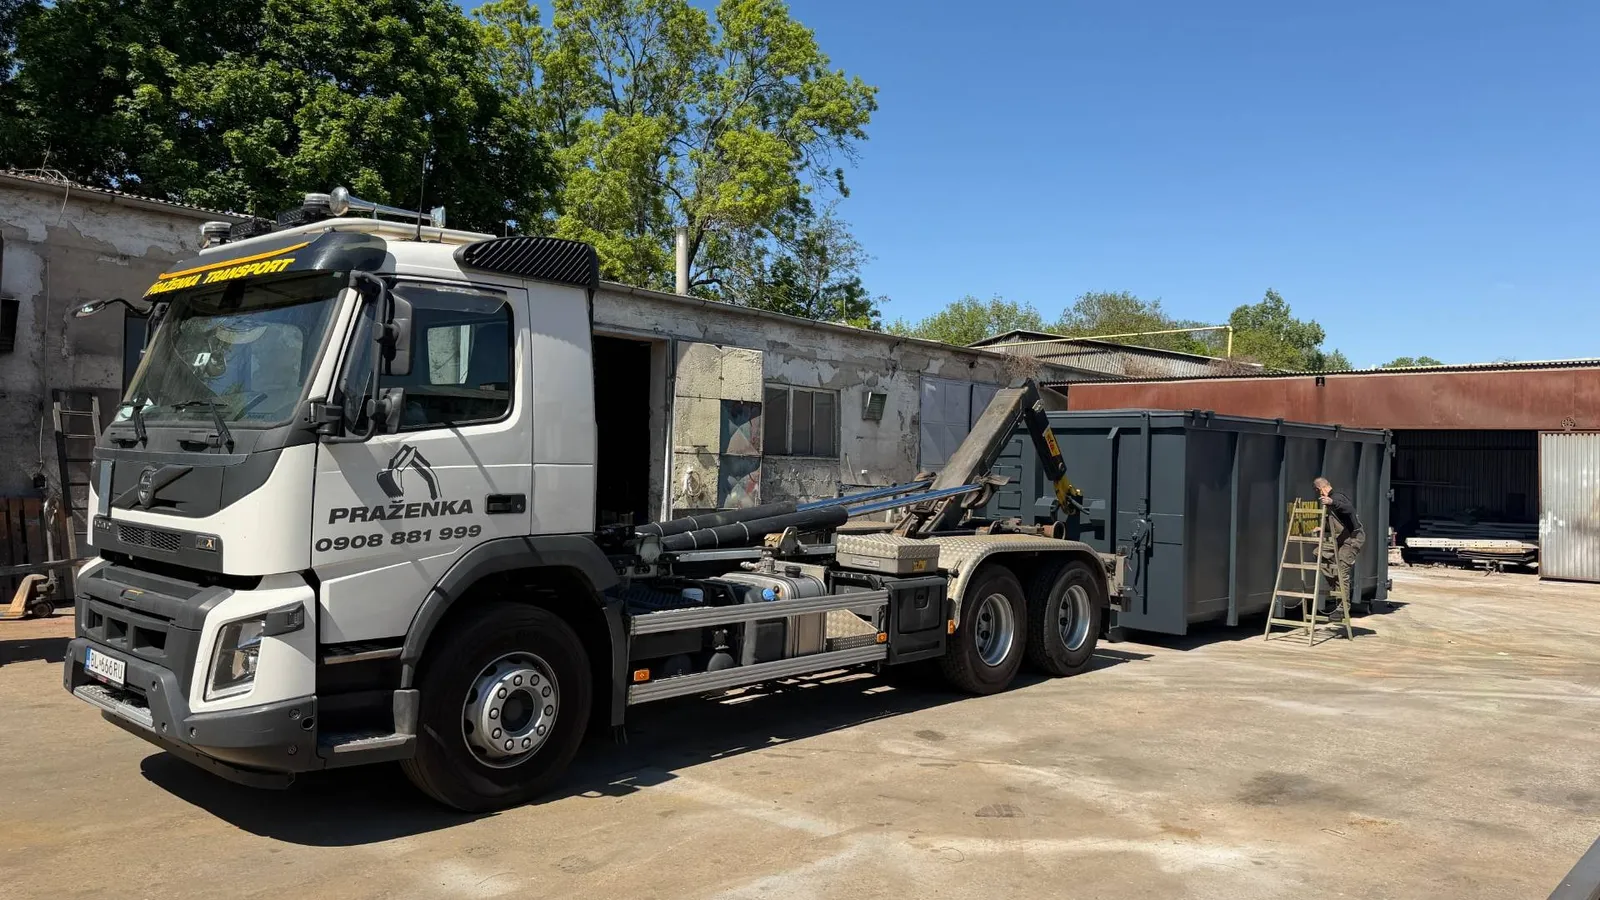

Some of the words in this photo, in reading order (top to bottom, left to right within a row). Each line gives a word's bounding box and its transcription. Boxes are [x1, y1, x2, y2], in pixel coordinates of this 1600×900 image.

[203, 258, 295, 284] TRANSPORT
[329, 500, 473, 524] PRAŽENKA
[315, 534, 383, 552] 0908
[390, 529, 432, 545] 881
[439, 525, 481, 540] 999
